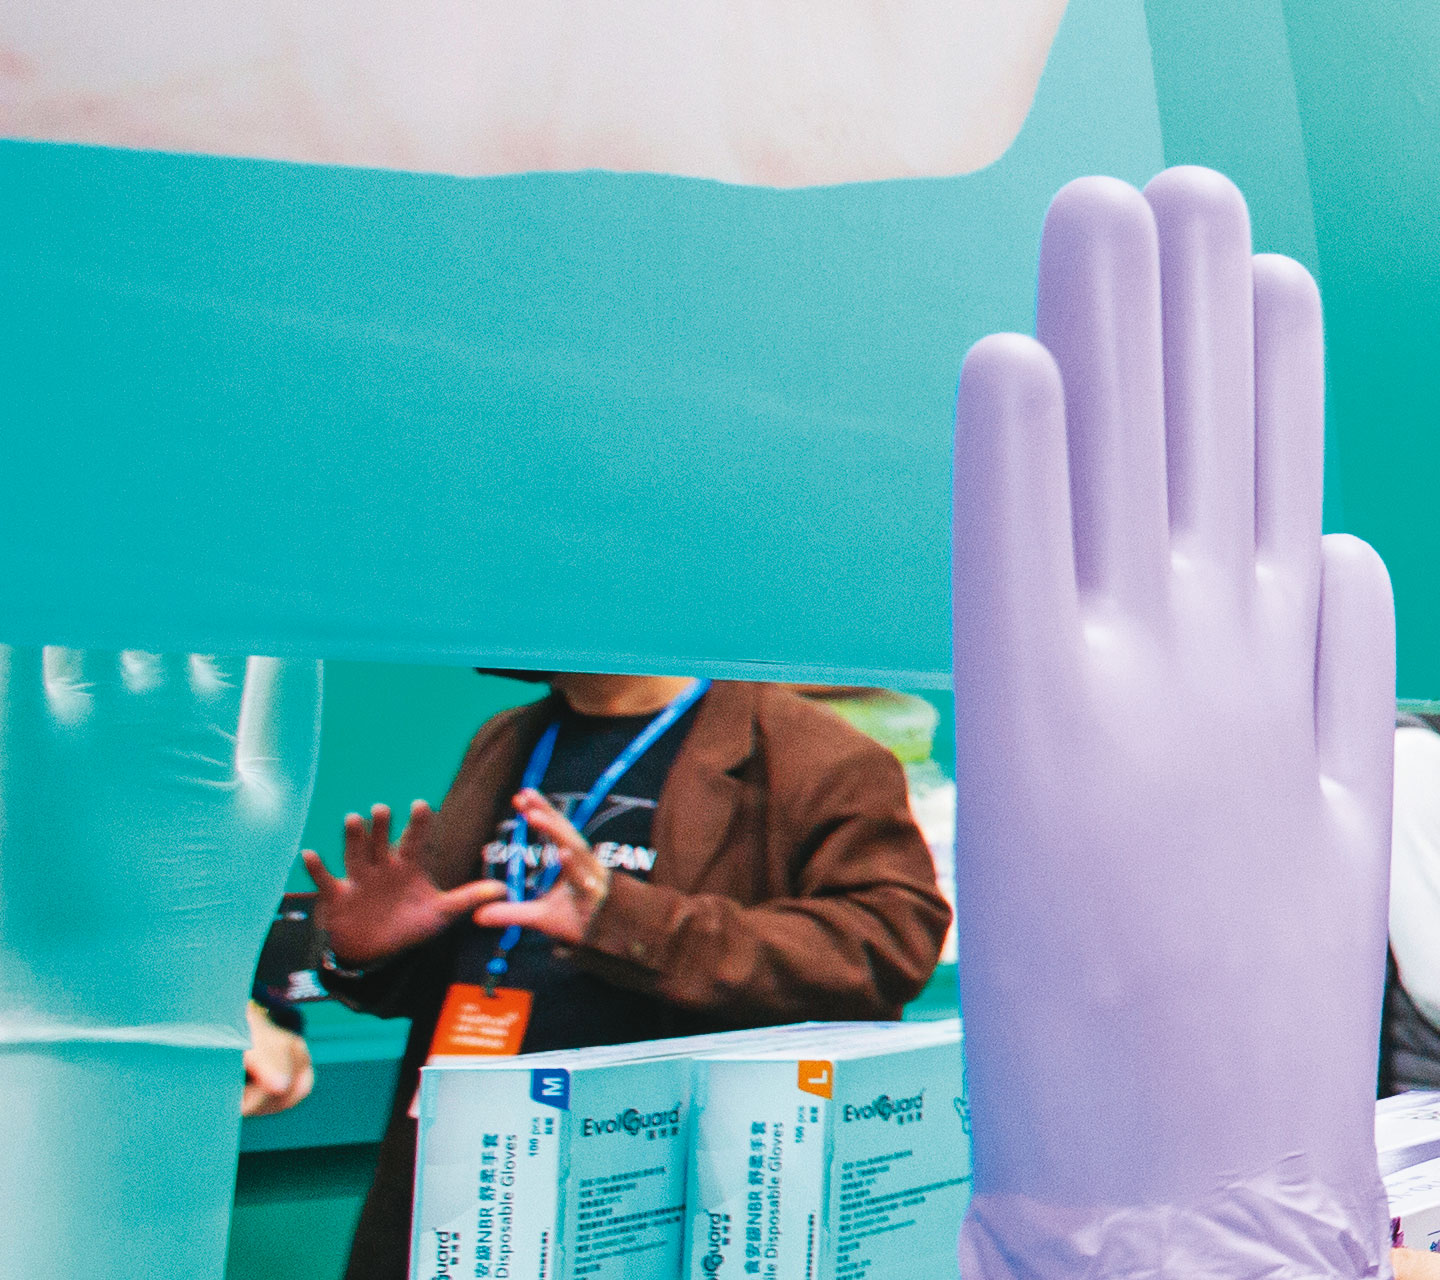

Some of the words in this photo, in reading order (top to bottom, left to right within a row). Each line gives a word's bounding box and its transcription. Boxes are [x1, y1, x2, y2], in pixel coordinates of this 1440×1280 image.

[541, 1076, 565, 1097] M
[808, 1070, 828, 1085] L
[499, 1133, 518, 1188] Gloves
[768, 1121, 784, 1173] Gloves
[494, 1191, 515, 1279] Disposable
[764, 1176, 783, 1259] Disposable
